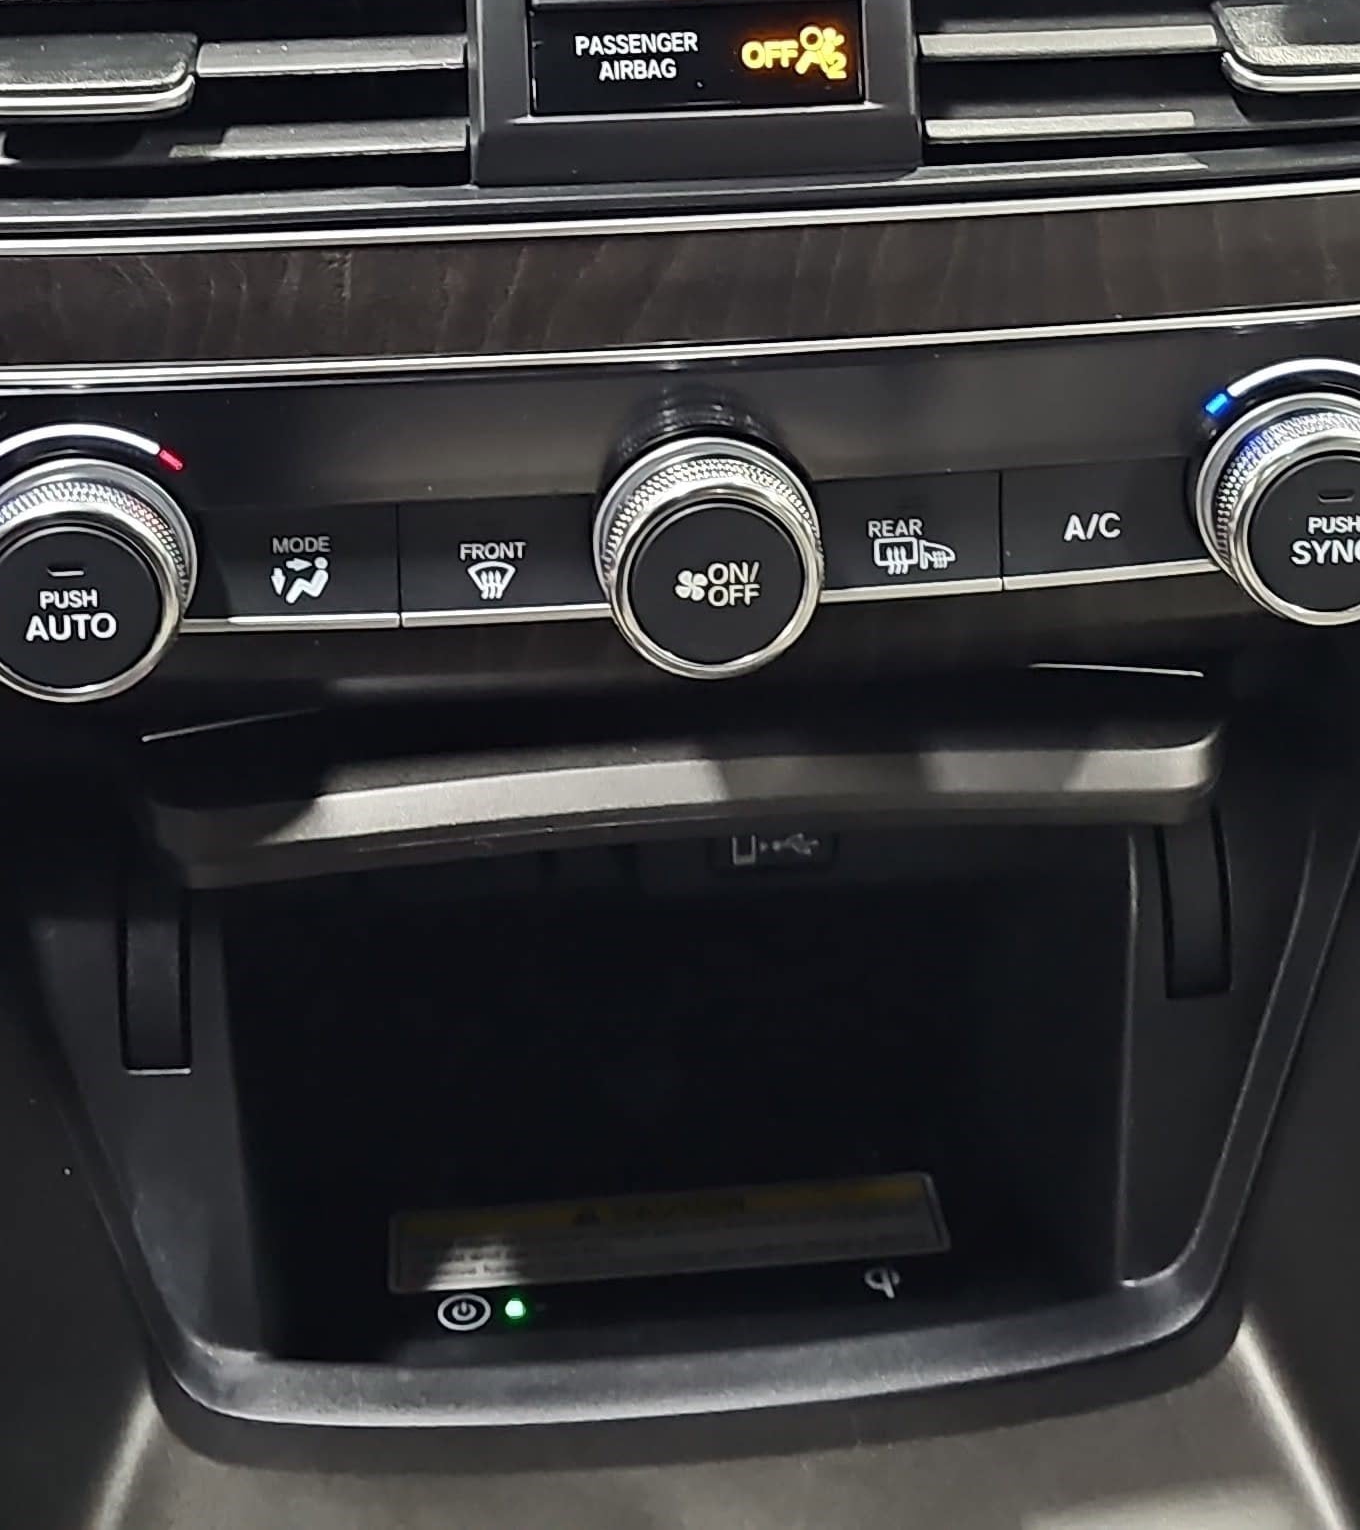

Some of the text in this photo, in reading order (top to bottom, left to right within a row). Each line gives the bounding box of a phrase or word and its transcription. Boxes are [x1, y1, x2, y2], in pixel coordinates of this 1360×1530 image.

[574, 31, 699, 56] PASSENGER
[741, 40, 798, 69] OFF
[599, 58, 677, 81] AIRBAG
[866, 519, 922, 539] REAR
[1063, 512, 1122, 541] A/C
[272, 535, 331, 554] MODE
[459, 540, 527, 562] FRONT
[706, 561, 760, 586] ON/
[39, 589, 98, 610] PUSH
[706, 583, 760, 608] OFF
[25, 613, 117, 642] AUTO
